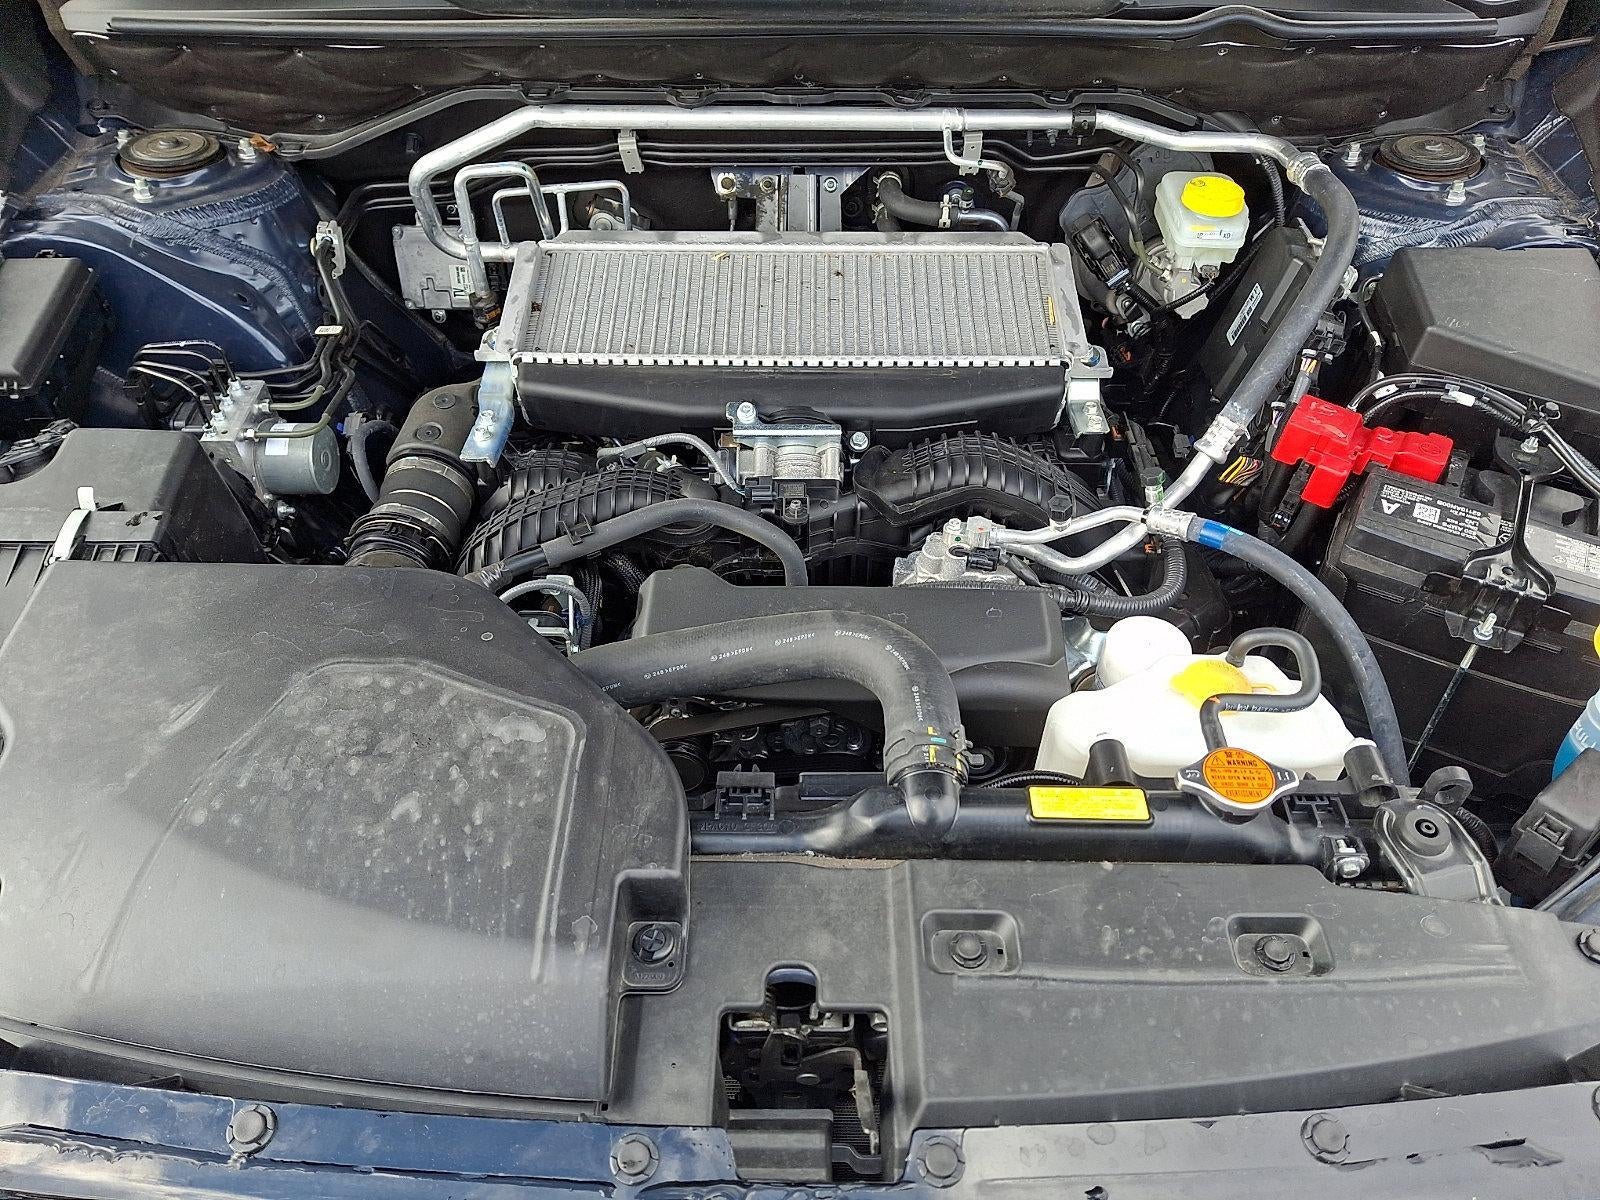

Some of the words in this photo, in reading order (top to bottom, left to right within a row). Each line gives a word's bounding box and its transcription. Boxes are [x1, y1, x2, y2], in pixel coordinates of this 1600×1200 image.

[1381, 499, 1401, 515] A
[1442, 521, 1463, 532] AMPS
[1226, 759, 1258, 767] WARNING
